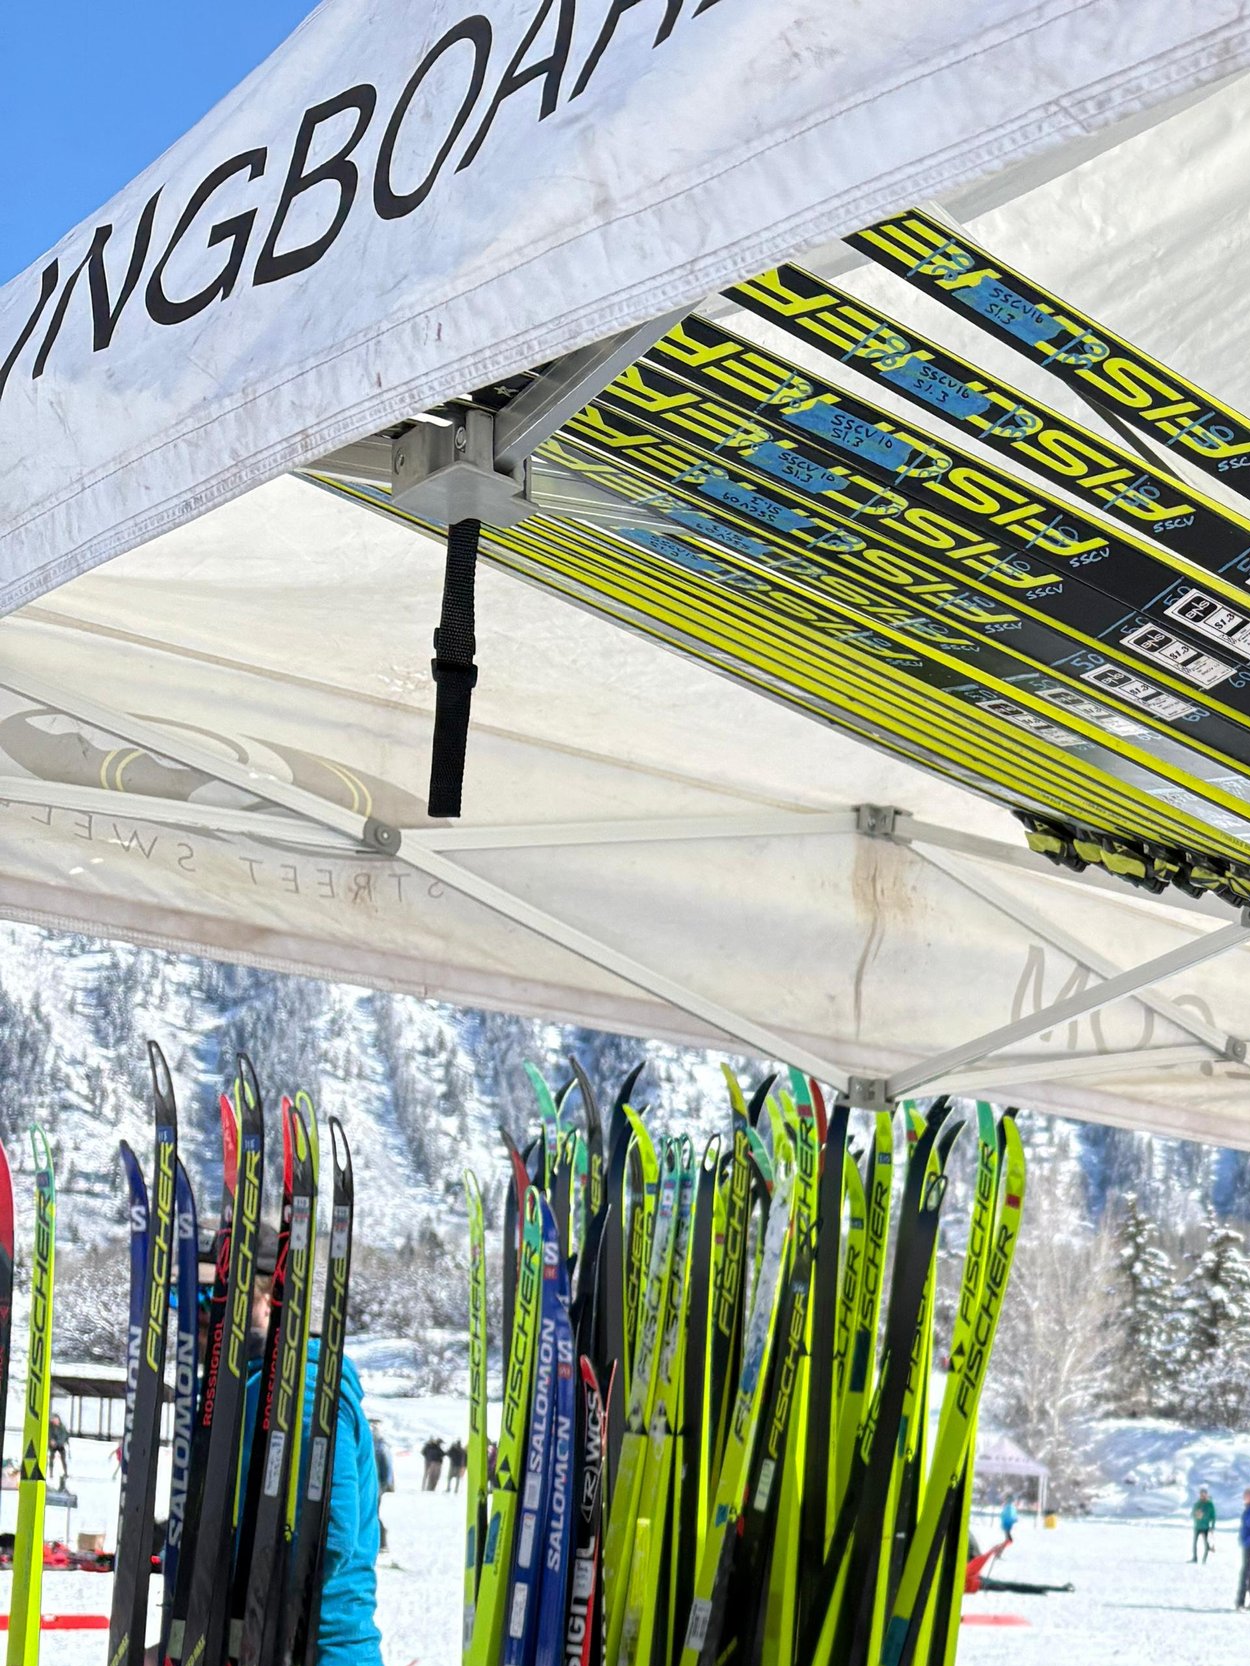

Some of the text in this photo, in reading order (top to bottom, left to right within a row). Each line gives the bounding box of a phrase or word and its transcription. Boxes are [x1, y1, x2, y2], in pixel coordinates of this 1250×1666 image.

[0, 0, 720, 391] INGBOA
[1025, 584, 1063, 600] SSCV
[1069, 547, 1110, 568] SSCV
[1153, 515, 1195, 533] SSCV
[984, 621, 1023, 634] SSCV
[1070, 653, 1105, 671] 50
[29, 1189, 55, 1420] FISCHER
[146, 1141, 174, 1374] FISCHER
[228, 1150, 261, 1378] FISCHER
[720, 1130, 750, 1336] FISCHER
[956, 1223, 1015, 1420] FISCHER
[960, 1140, 994, 1328] FISCHER
[202, 1319, 225, 1428] ROSSIGNOL
[505, 1241, 538, 1440] FISCHER
[530, 1318, 556, 1473] SALOMON
[768, 1291, 807, 1460] FISCHER
[168, 1331, 195, 1548] SALOMON
[547, 1414, 571, 1571] SALOMON
